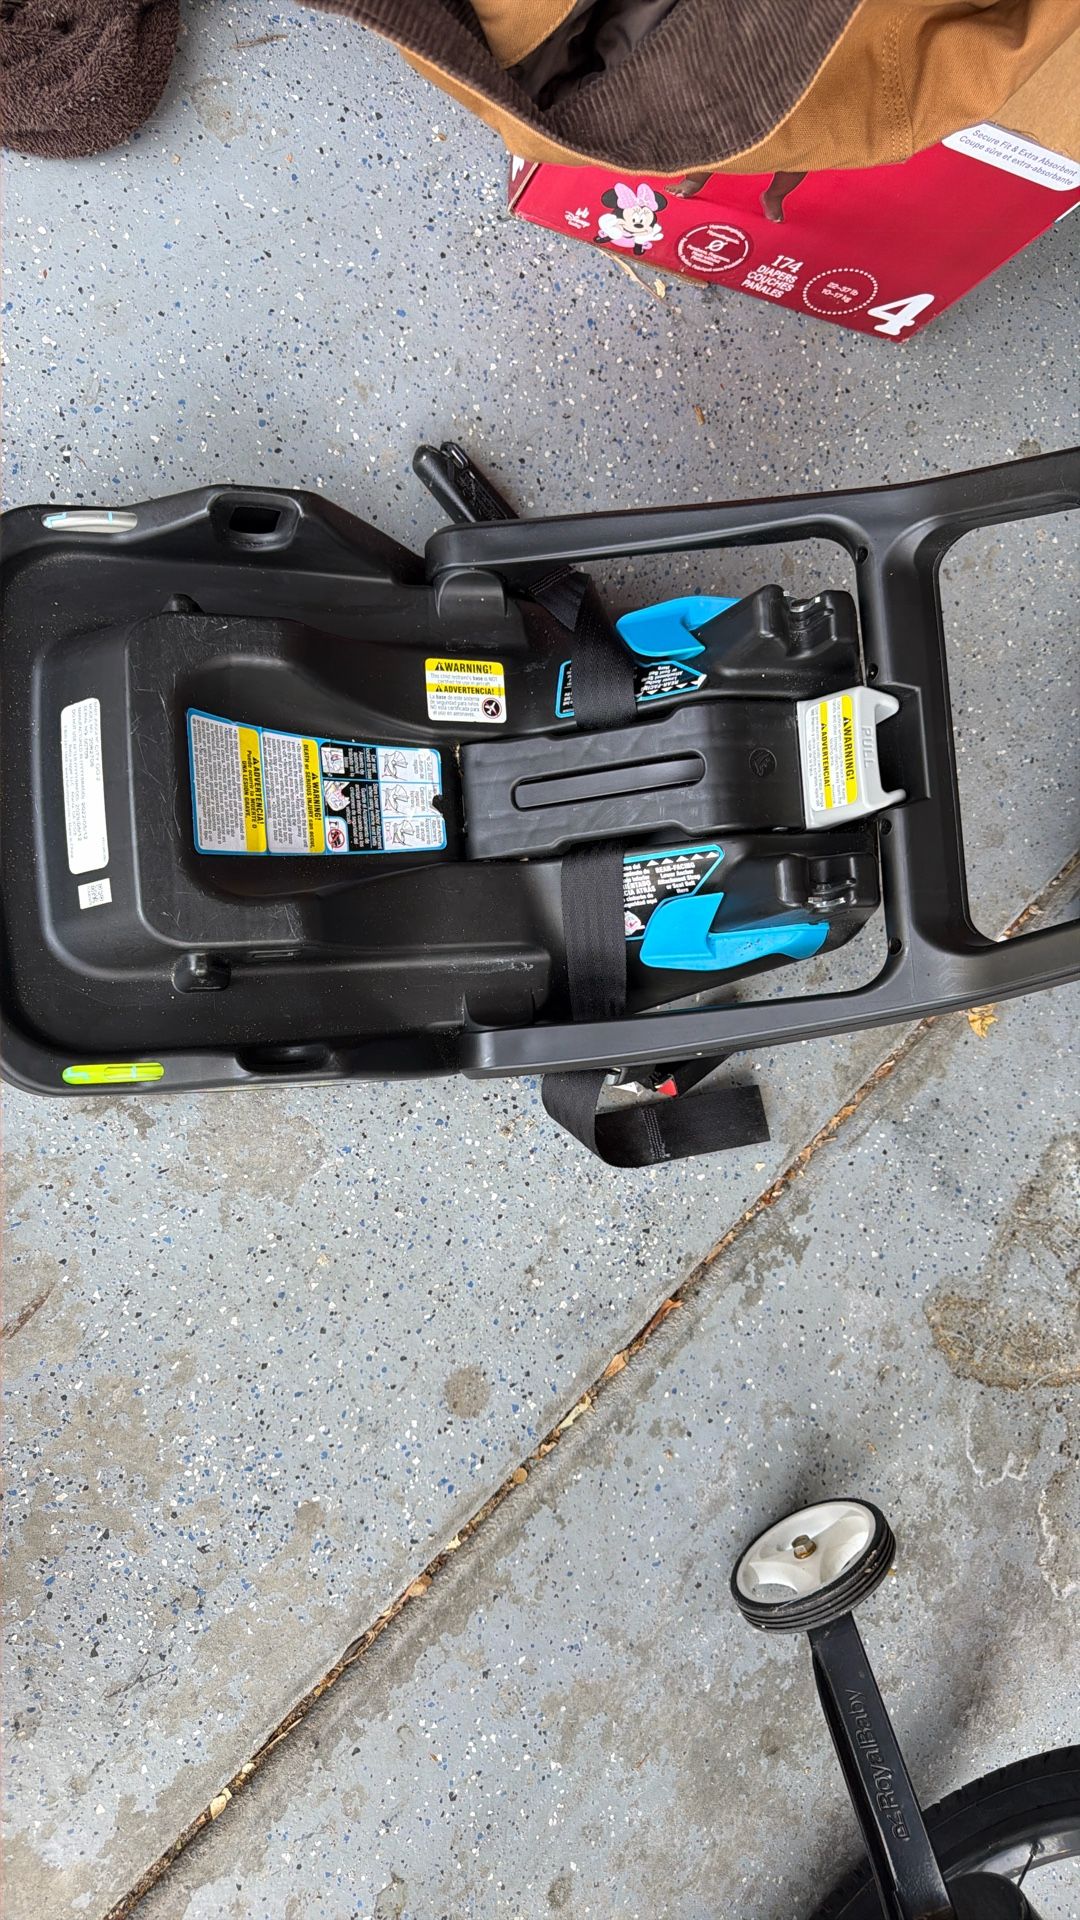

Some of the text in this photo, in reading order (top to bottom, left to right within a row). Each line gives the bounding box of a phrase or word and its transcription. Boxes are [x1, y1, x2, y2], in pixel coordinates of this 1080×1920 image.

[960, 136, 984, 151] Coupe
[1002, 152, 1012, 160] et
[1012, 156, 1073, 185] extra-absorbante
[973, 130, 999, 145] Secure
[1000, 140, 1011, 150] Fit
[1018, 148, 1038, 161] Extra
[1038, 157, 1077, 177] Absorbent
[747, 272, 794, 291] COUCHES
[757, 265, 798, 284] DIAPERS
[771, 255, 803, 274] 174
[741, 278, 784, 299] PAÑALES
[867, 294, 935, 336] 4
[444, 662, 492, 673] WARNING!
[443, 685, 494, 694] ADVERTENCIA!
[821, 730, 830, 787] ADVERTENCIA!
[843, 725, 854, 780] WARNING!
[862, 727, 874, 768] PULL
[253, 766, 263, 824] ADVERTENCIA!
[312, 782, 320, 820] WARNING!
[655, 862, 695, 873] REAR-FACING
[846, 1690, 899, 1811] RoyalBaby
